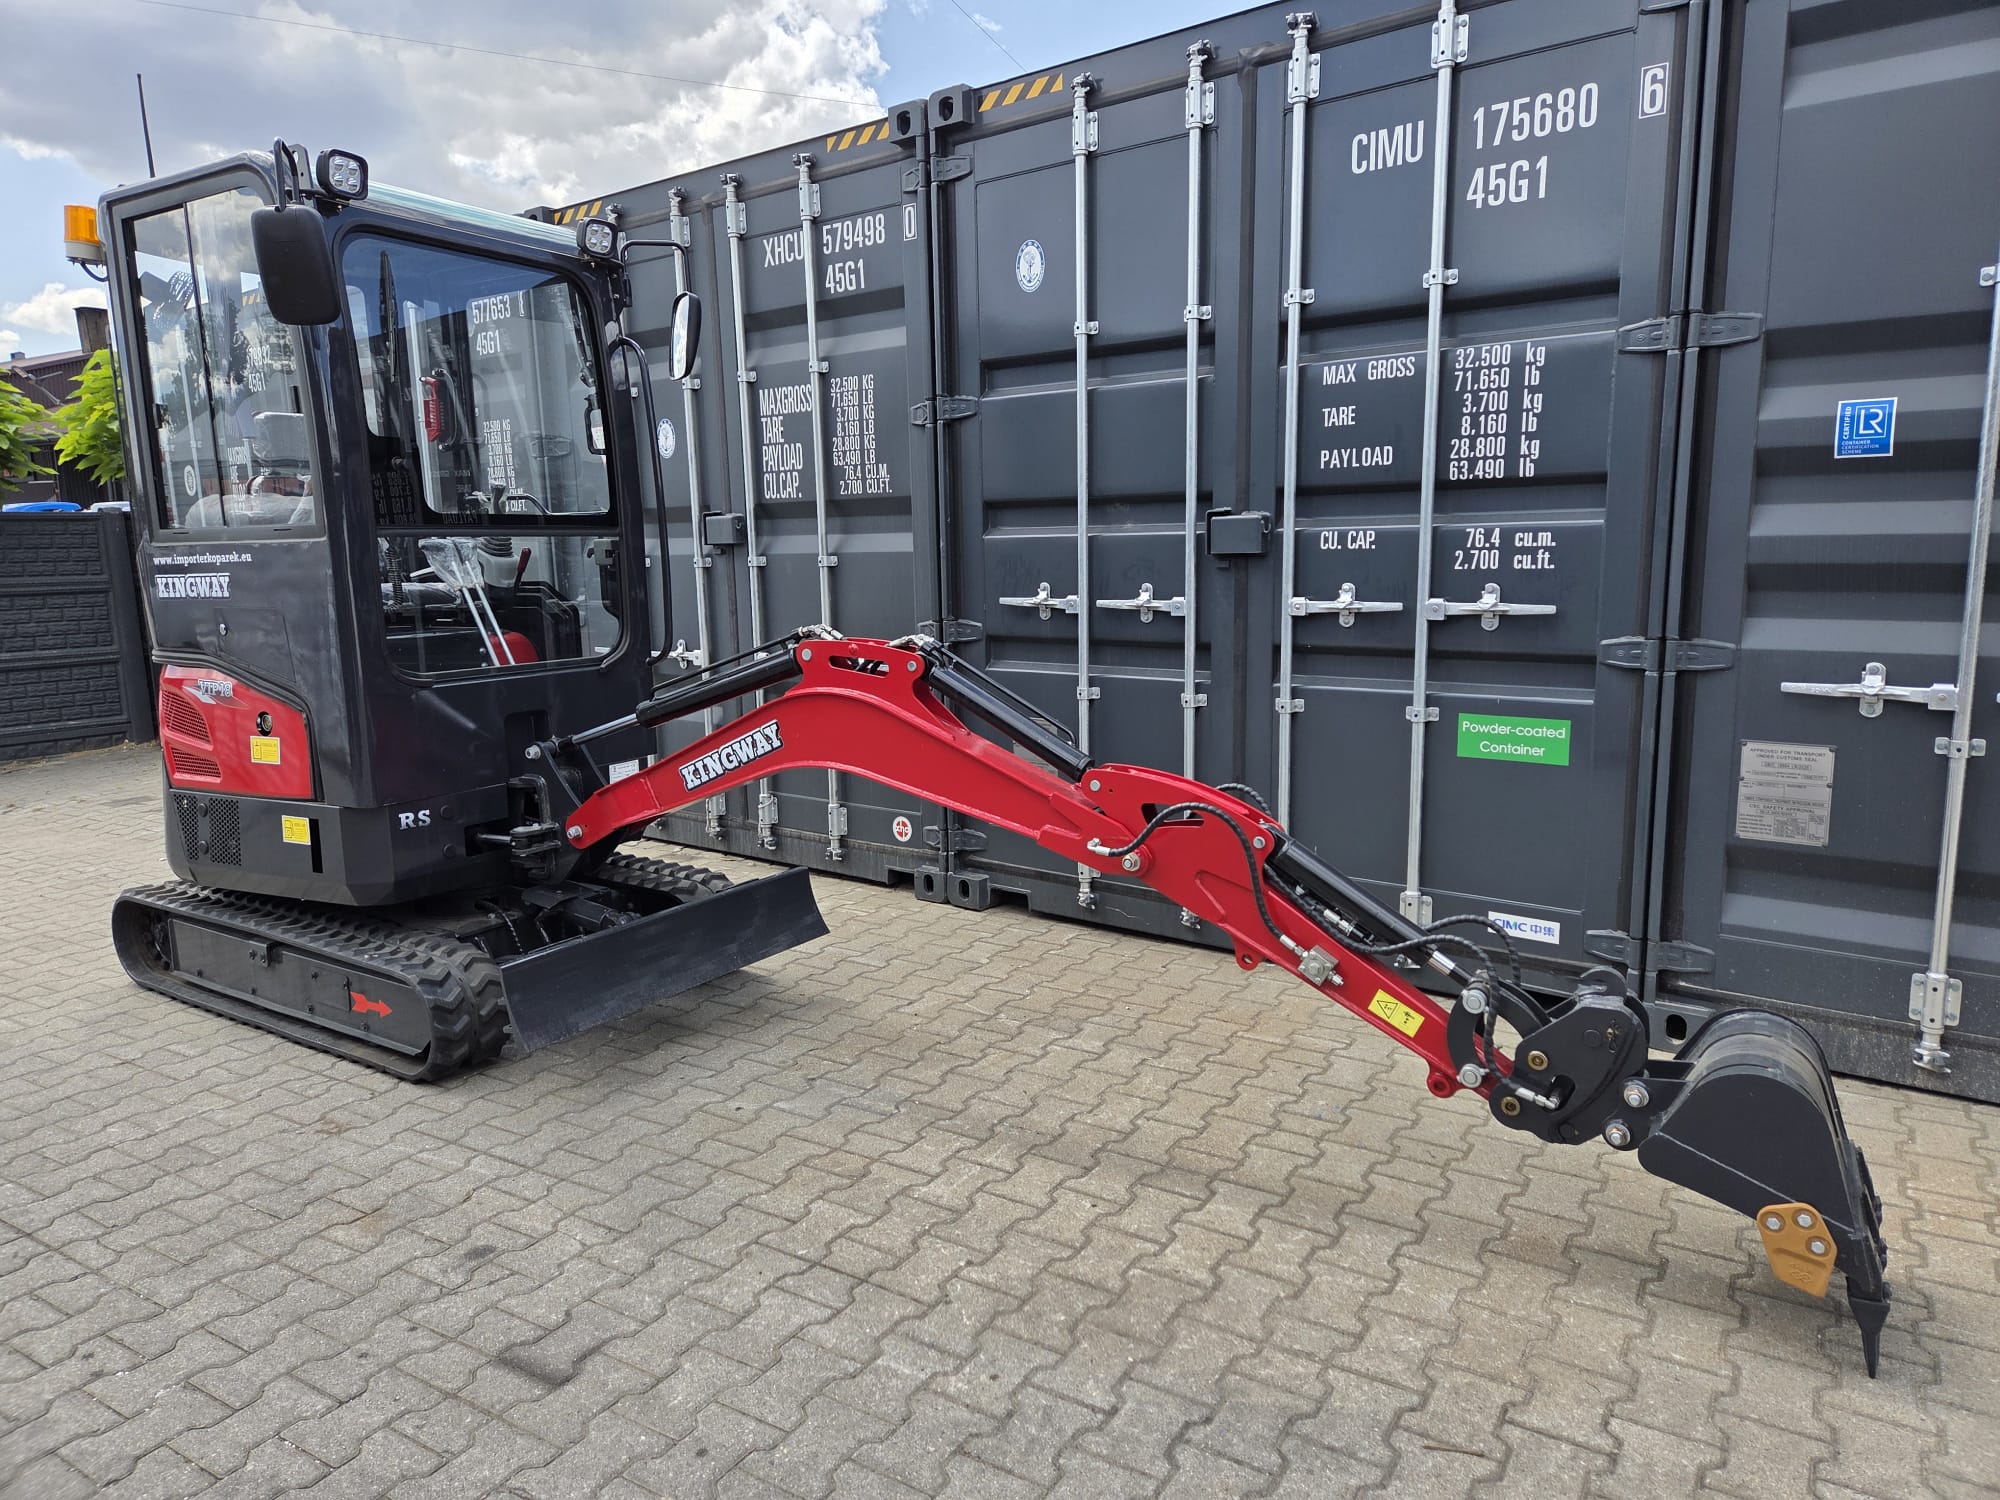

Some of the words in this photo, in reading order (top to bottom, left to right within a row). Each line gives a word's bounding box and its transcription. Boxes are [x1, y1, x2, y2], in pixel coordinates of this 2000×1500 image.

[1351, 119, 1425, 175] CIMU
[1472, 82, 1599, 150] 175680
[1642, 67, 1665, 114] 6
[1466, 155, 1548, 209] 45G1
[762, 230, 804, 268] XHCU
[822, 213, 886, 254] 579498
[905, 206, 915, 238] 0
[825, 258, 865, 294] 45G1
[471, 294, 511, 325] 577653
[476, 329, 500, 356] 45G1
[1322, 363, 1357, 386] MAX
[1367, 356, 1416, 381] GROSS
[1455, 343, 1512, 369] 32,500
[1525, 342, 1546, 367] kg
[1454, 367, 1510, 391] 71,650
[1524, 364, 1540, 386] lb
[759, 383, 812, 417] MAXGROSS
[862, 374, 874, 390] KG
[863, 389, 874, 405] LB
[1322, 405, 1356, 428] TARE
[1462, 390, 1509, 414] 3,700
[1523, 389, 1543, 413] kg
[761, 415, 784, 444] TARE
[863, 404, 875, 420] KG
[864, 419, 874, 435] LB
[1461, 413, 1507, 436] 8,160
[1521, 411, 1538, 433] lb
[1842, 406, 1852, 440] CERTIFIED
[1859, 408, 1883, 434] LR
[762, 443, 803, 472] PAYLOAD
[864, 434, 876, 450] KG
[865, 449, 876, 464] LB
[1320, 445, 1393, 470] PAYLOAD
[1450, 436, 1506, 459] 28,800
[1519, 435, 1540, 460] kg
[764, 472, 802, 499] CU.CAP.
[844, 465, 861, 480] 76.4
[865, 463, 890, 479] CU.M.
[1449, 458, 1504, 481] 63,490
[1519, 457, 1535, 478] lb
[867, 478, 893, 493] CU.FT.
[1320, 530, 1342, 550] CU.
[1347, 530, 1376, 550] CAP.
[1465, 528, 1501, 548] 76.4
[1514, 531, 1557, 548] cu.m.
[152, 551, 253, 567] www.importerkoparek.eu
[1453, 549, 1500, 570] 2,700
[1513, 549, 1555, 570] cu.ft.
[156, 575, 230, 598] KINGWAY
[1462, 721, 1566, 738] Powder-coated
[679, 721, 784, 791] KINGWAY
[1480, 741, 1545, 756] Container
[398, 809, 431, 830] RS
